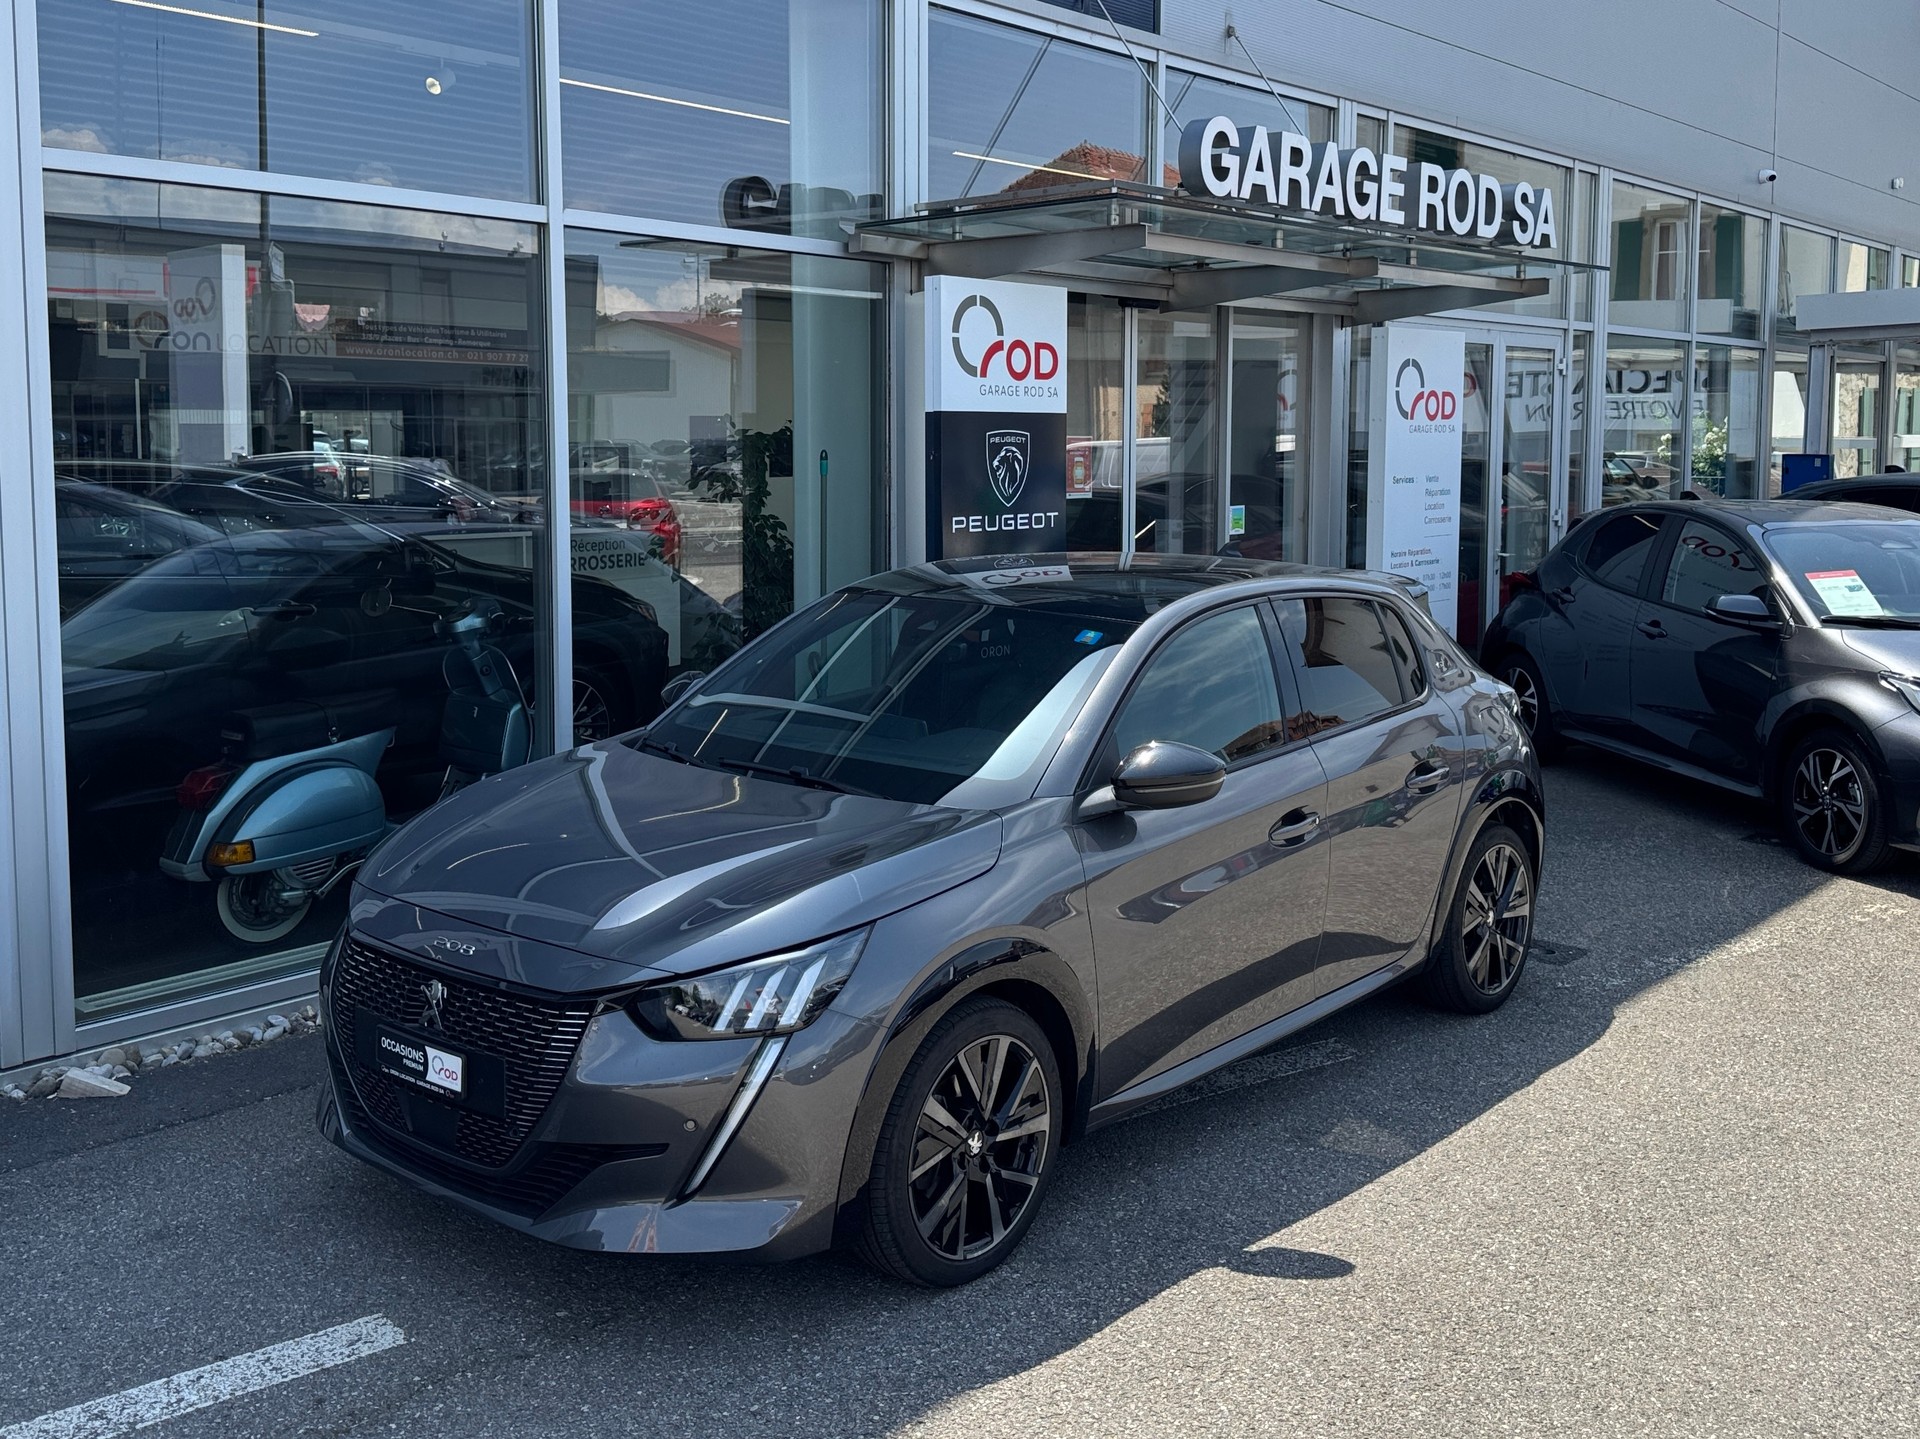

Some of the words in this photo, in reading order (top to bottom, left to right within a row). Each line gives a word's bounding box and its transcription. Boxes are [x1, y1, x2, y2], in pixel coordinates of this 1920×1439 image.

[1200, 115, 1408, 225] GARAGE
[1418, 161, 1503, 239] ROD
[1512, 181, 1558, 249] SA
[398, 324, 407, 332] de
[216, 331, 328, 356] LOCATION
[467, 351, 483, 360] 021
[487, 352, 503, 361] 907
[506, 353, 517, 362] 77
[979, 384, 1021, 397] GARAGE
[1023, 385, 1045, 398] ROD
[1047, 386, 1059, 398] SA
[1408, 424, 1433, 434] GARAGE
[1434, 424, 1447, 434] ROD
[1448, 424, 1456, 433] SA
[989, 435, 1027, 444] PEUGEOT
[1392, 475, 1415, 485] Services
[1425, 474, 1440, 483] Vente
[1424, 502, 1445, 511] Location
[952, 511, 1059, 534] PEUGEOT
[570, 537, 626, 554] Réception
[570, 551, 646, 572] RROSSERIE
[980, 644, 1011, 659] ORON
[433, 935, 476, 956] 208
[380, 1036, 425, 1063] OCCASIONS
